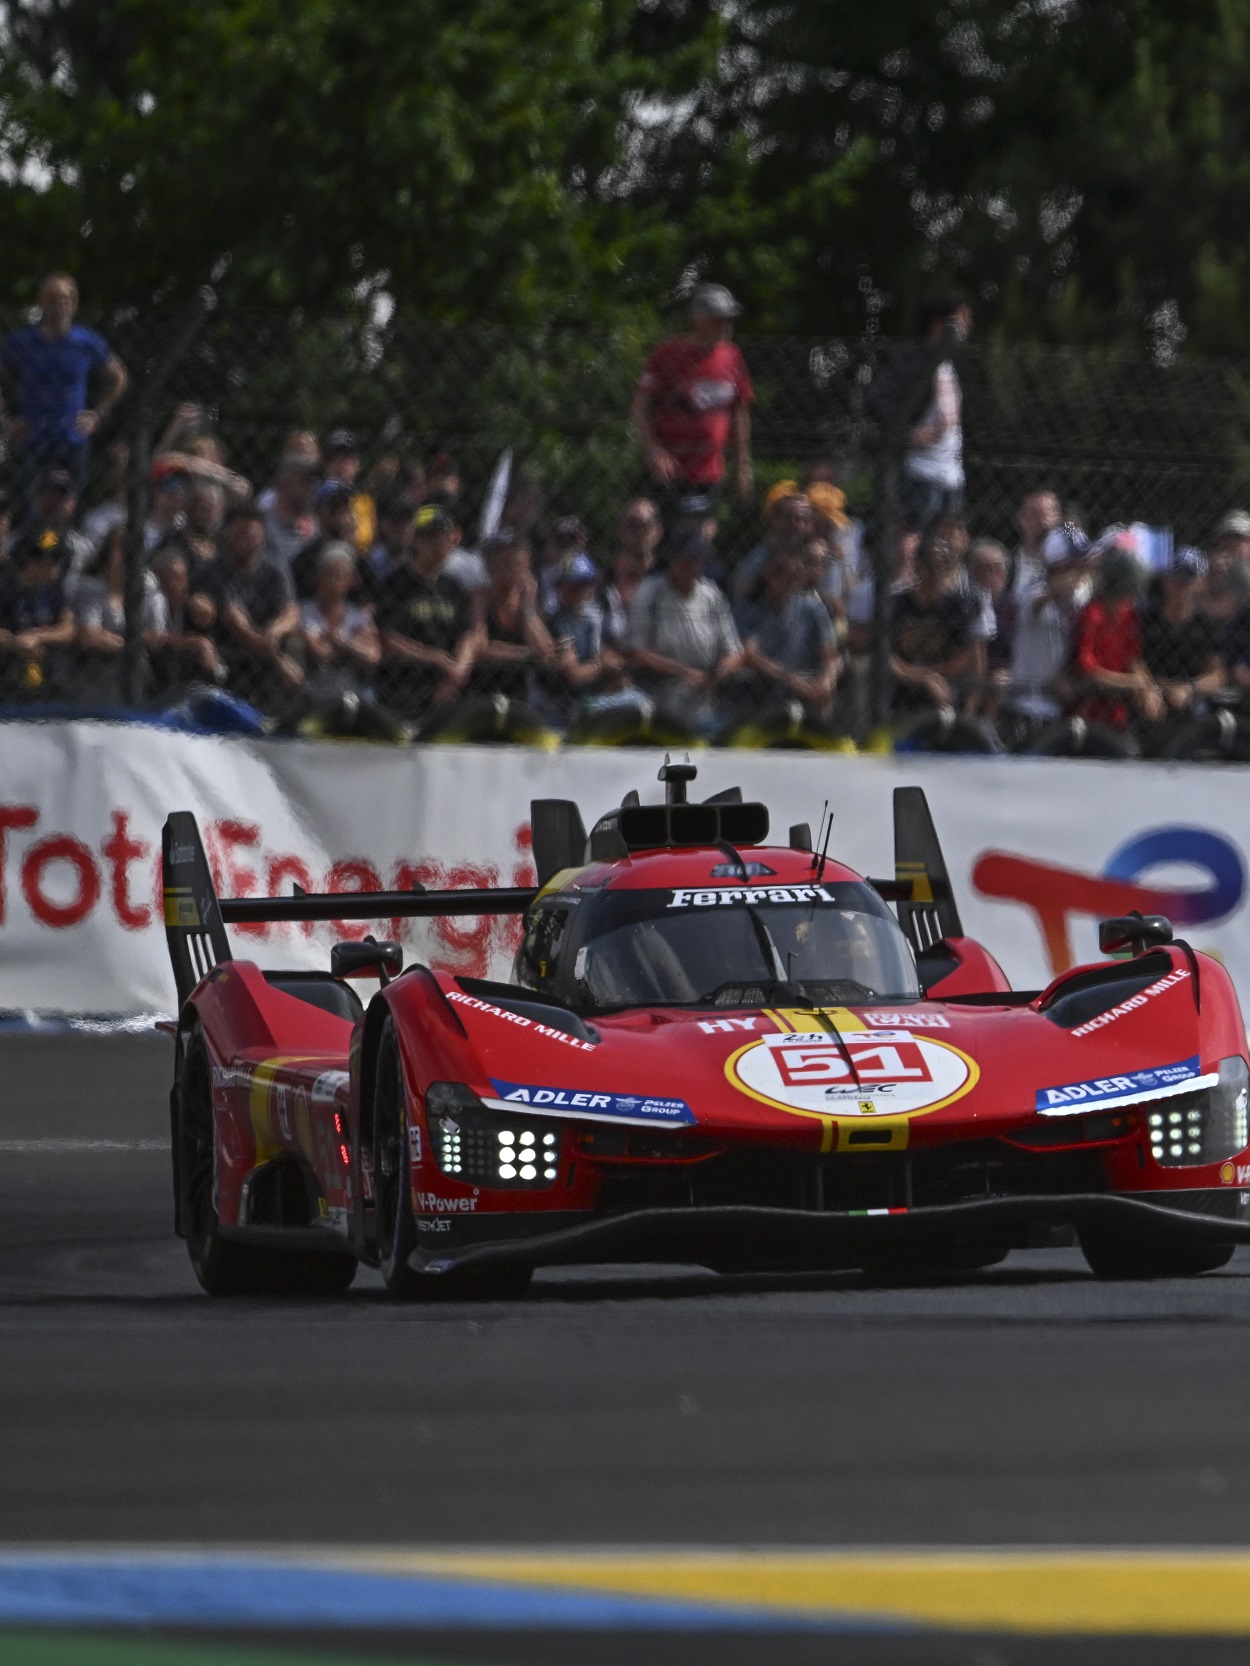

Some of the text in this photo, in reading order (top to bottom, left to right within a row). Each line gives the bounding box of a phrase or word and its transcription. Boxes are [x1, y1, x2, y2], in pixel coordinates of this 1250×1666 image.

[665, 884, 836, 908] Ferrari
[1070, 968, 1191, 1037] RICHARD MILLE
[445, 991, 597, 1052] RICHARD MILLE
[697, 1017, 757, 1034] HY
[780, 1046, 924, 1081] 51
[1161, 1071, 1196, 1082] GROUP
[503, 1088, 612, 1109] ADLER
[824, 1083, 897, 1095] WEC
[1044, 1076, 1138, 1104] ADLER
[640, 1105, 681, 1115] GROUP
[417, 1192, 478, 1211] V-Power
